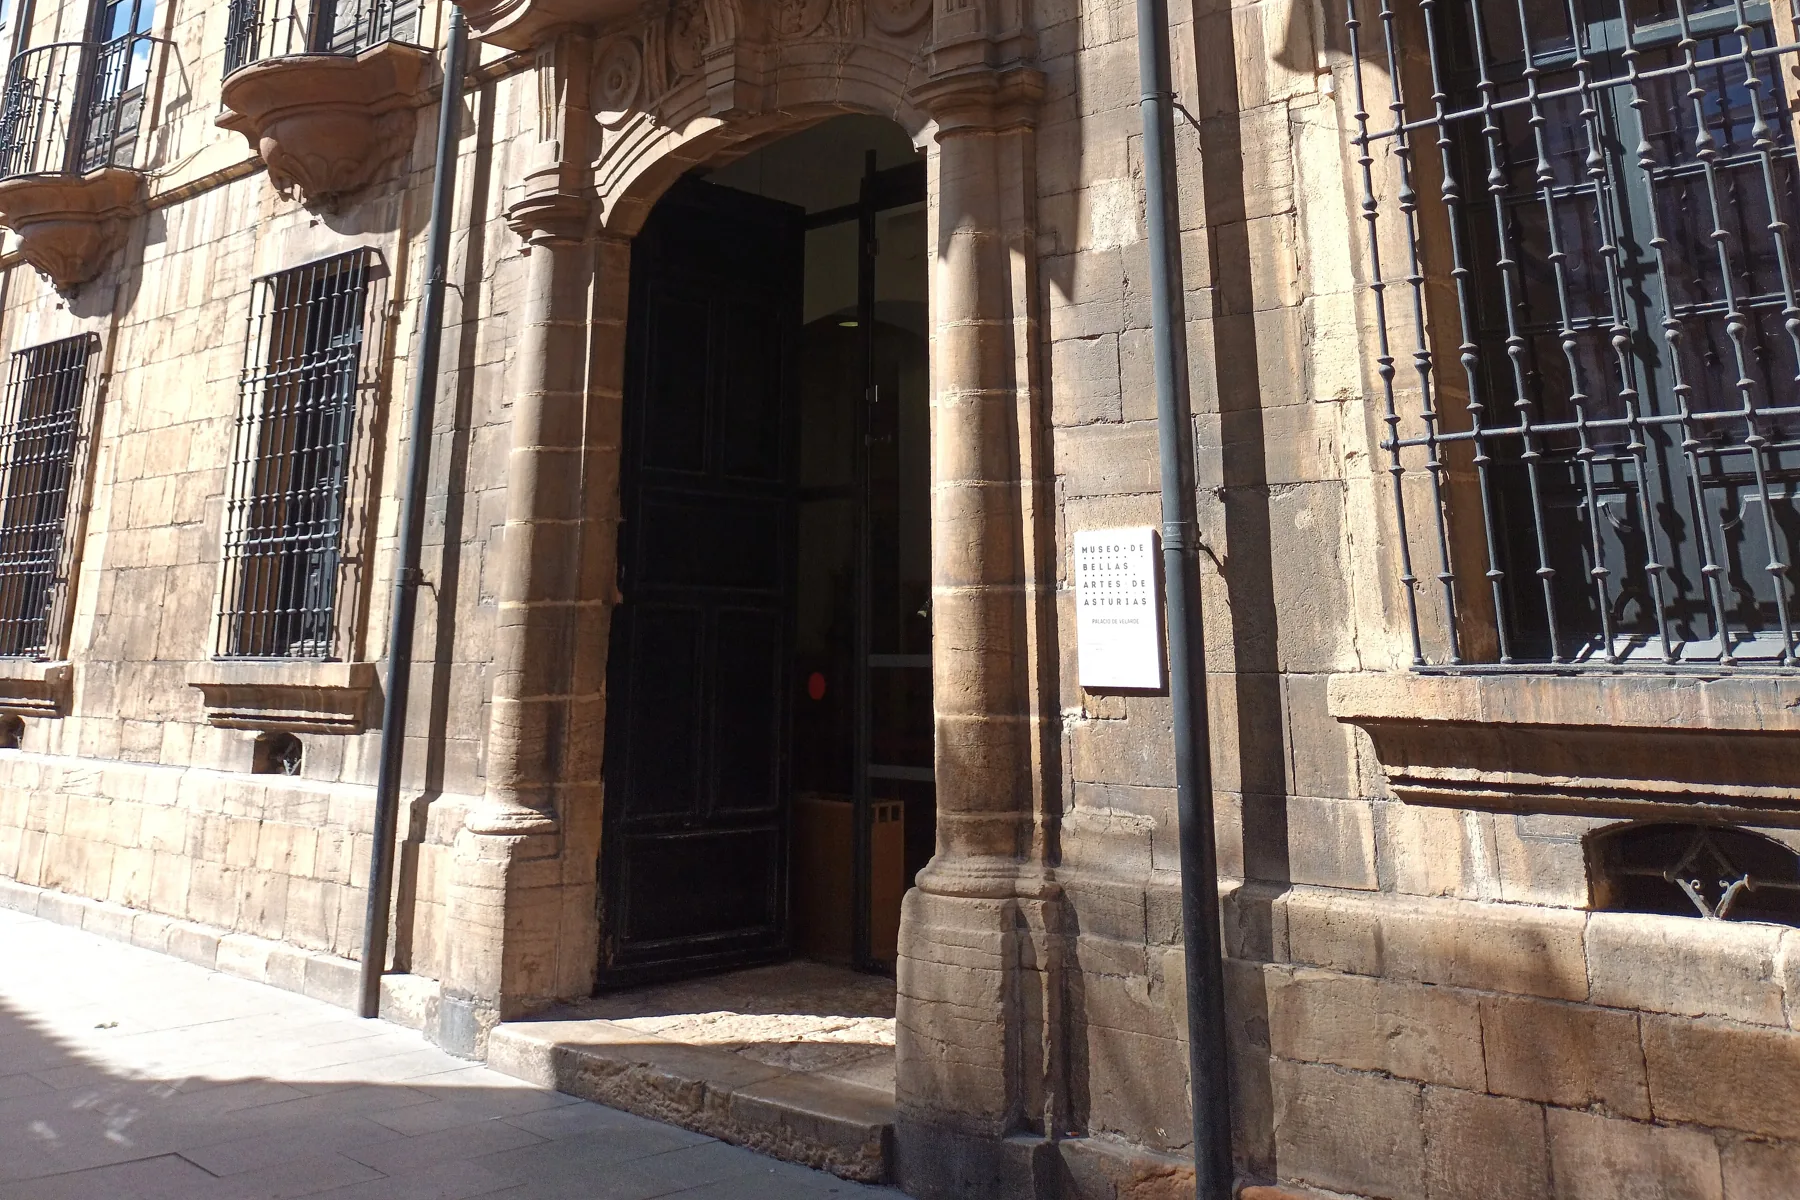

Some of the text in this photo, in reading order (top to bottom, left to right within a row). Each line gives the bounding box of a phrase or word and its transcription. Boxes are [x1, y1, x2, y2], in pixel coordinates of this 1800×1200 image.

[1081, 544, 1144, 554] MUSEO DE
[1083, 562, 1128, 571] BELLAS
[1083, 580, 1146, 589] ARTES DE
[1084, 598, 1147, 606] ASTURIAS
